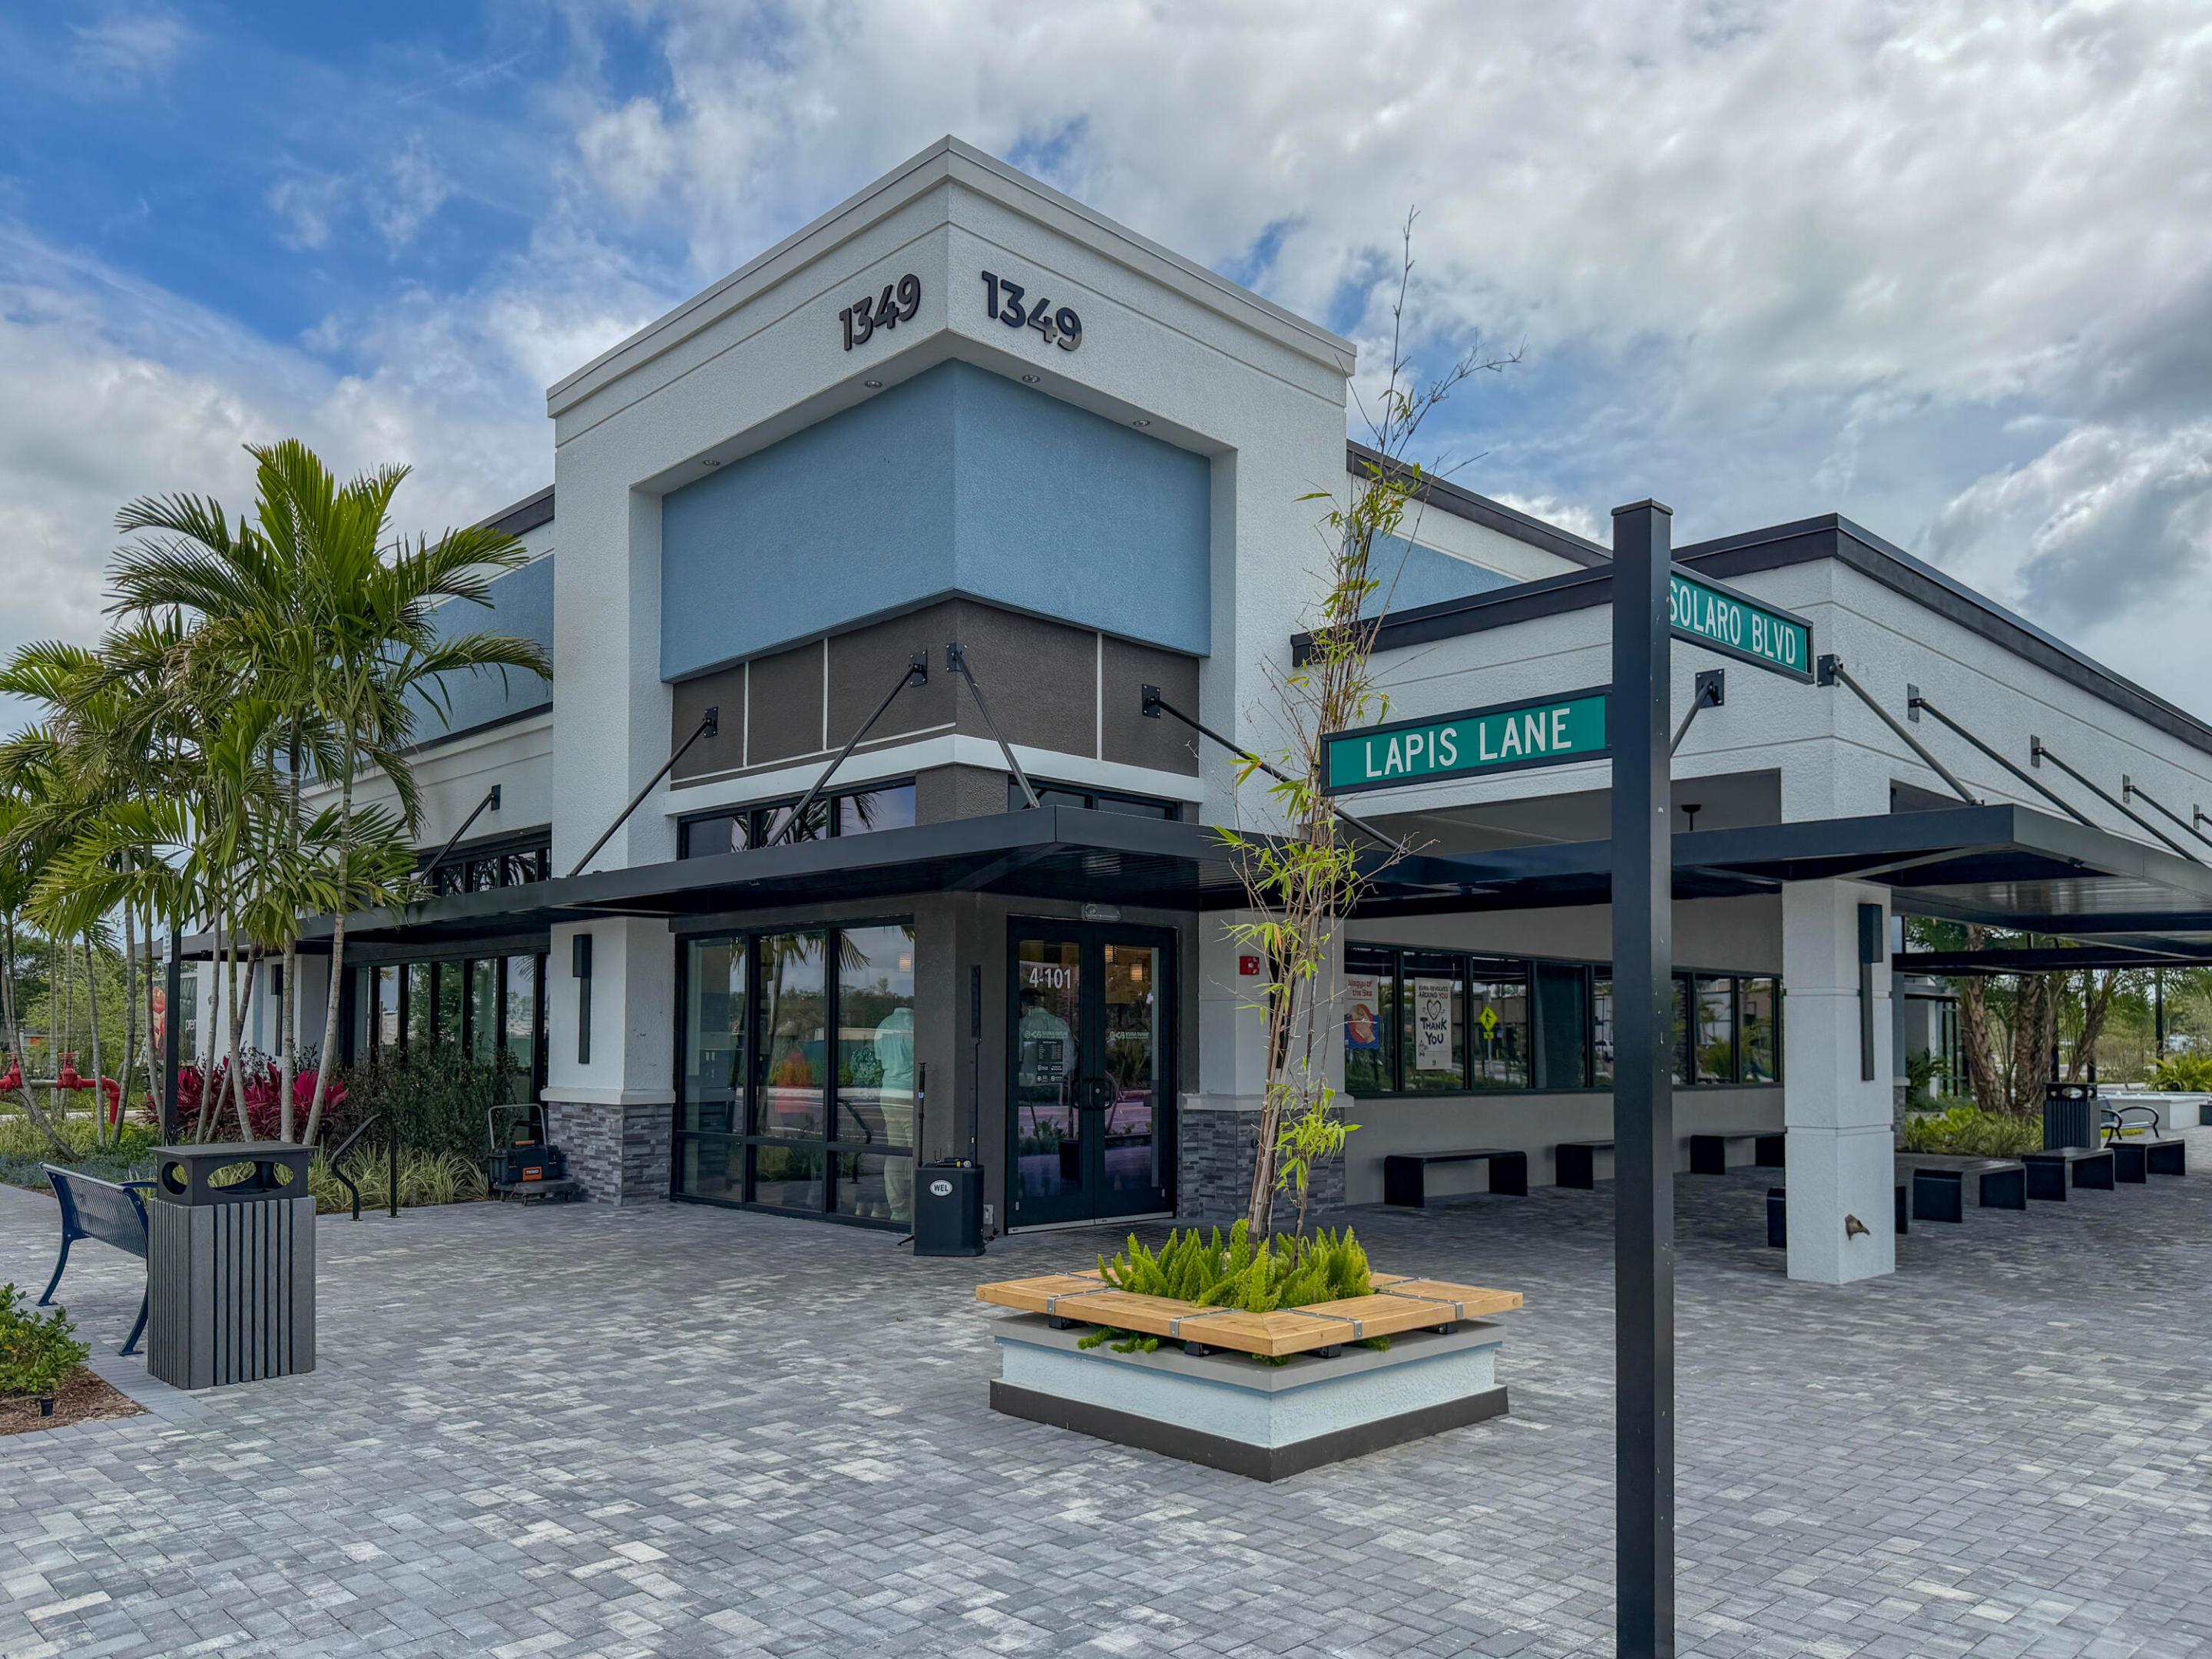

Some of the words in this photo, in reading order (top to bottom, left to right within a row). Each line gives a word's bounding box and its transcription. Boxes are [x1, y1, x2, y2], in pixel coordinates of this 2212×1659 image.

[839, 273, 921, 352] 1349
[982, 270, 1082, 352] 1349
[1670, 580, 1741, 645] SOLARO
[1752, 614, 1796, 664] BLVD
[1366, 727, 1458, 778] LAPIS
[1479, 707, 1571, 761] LANE
[1029, 967, 1071, 989] 4-101
[1420, 1017, 1447, 1030] THANK
